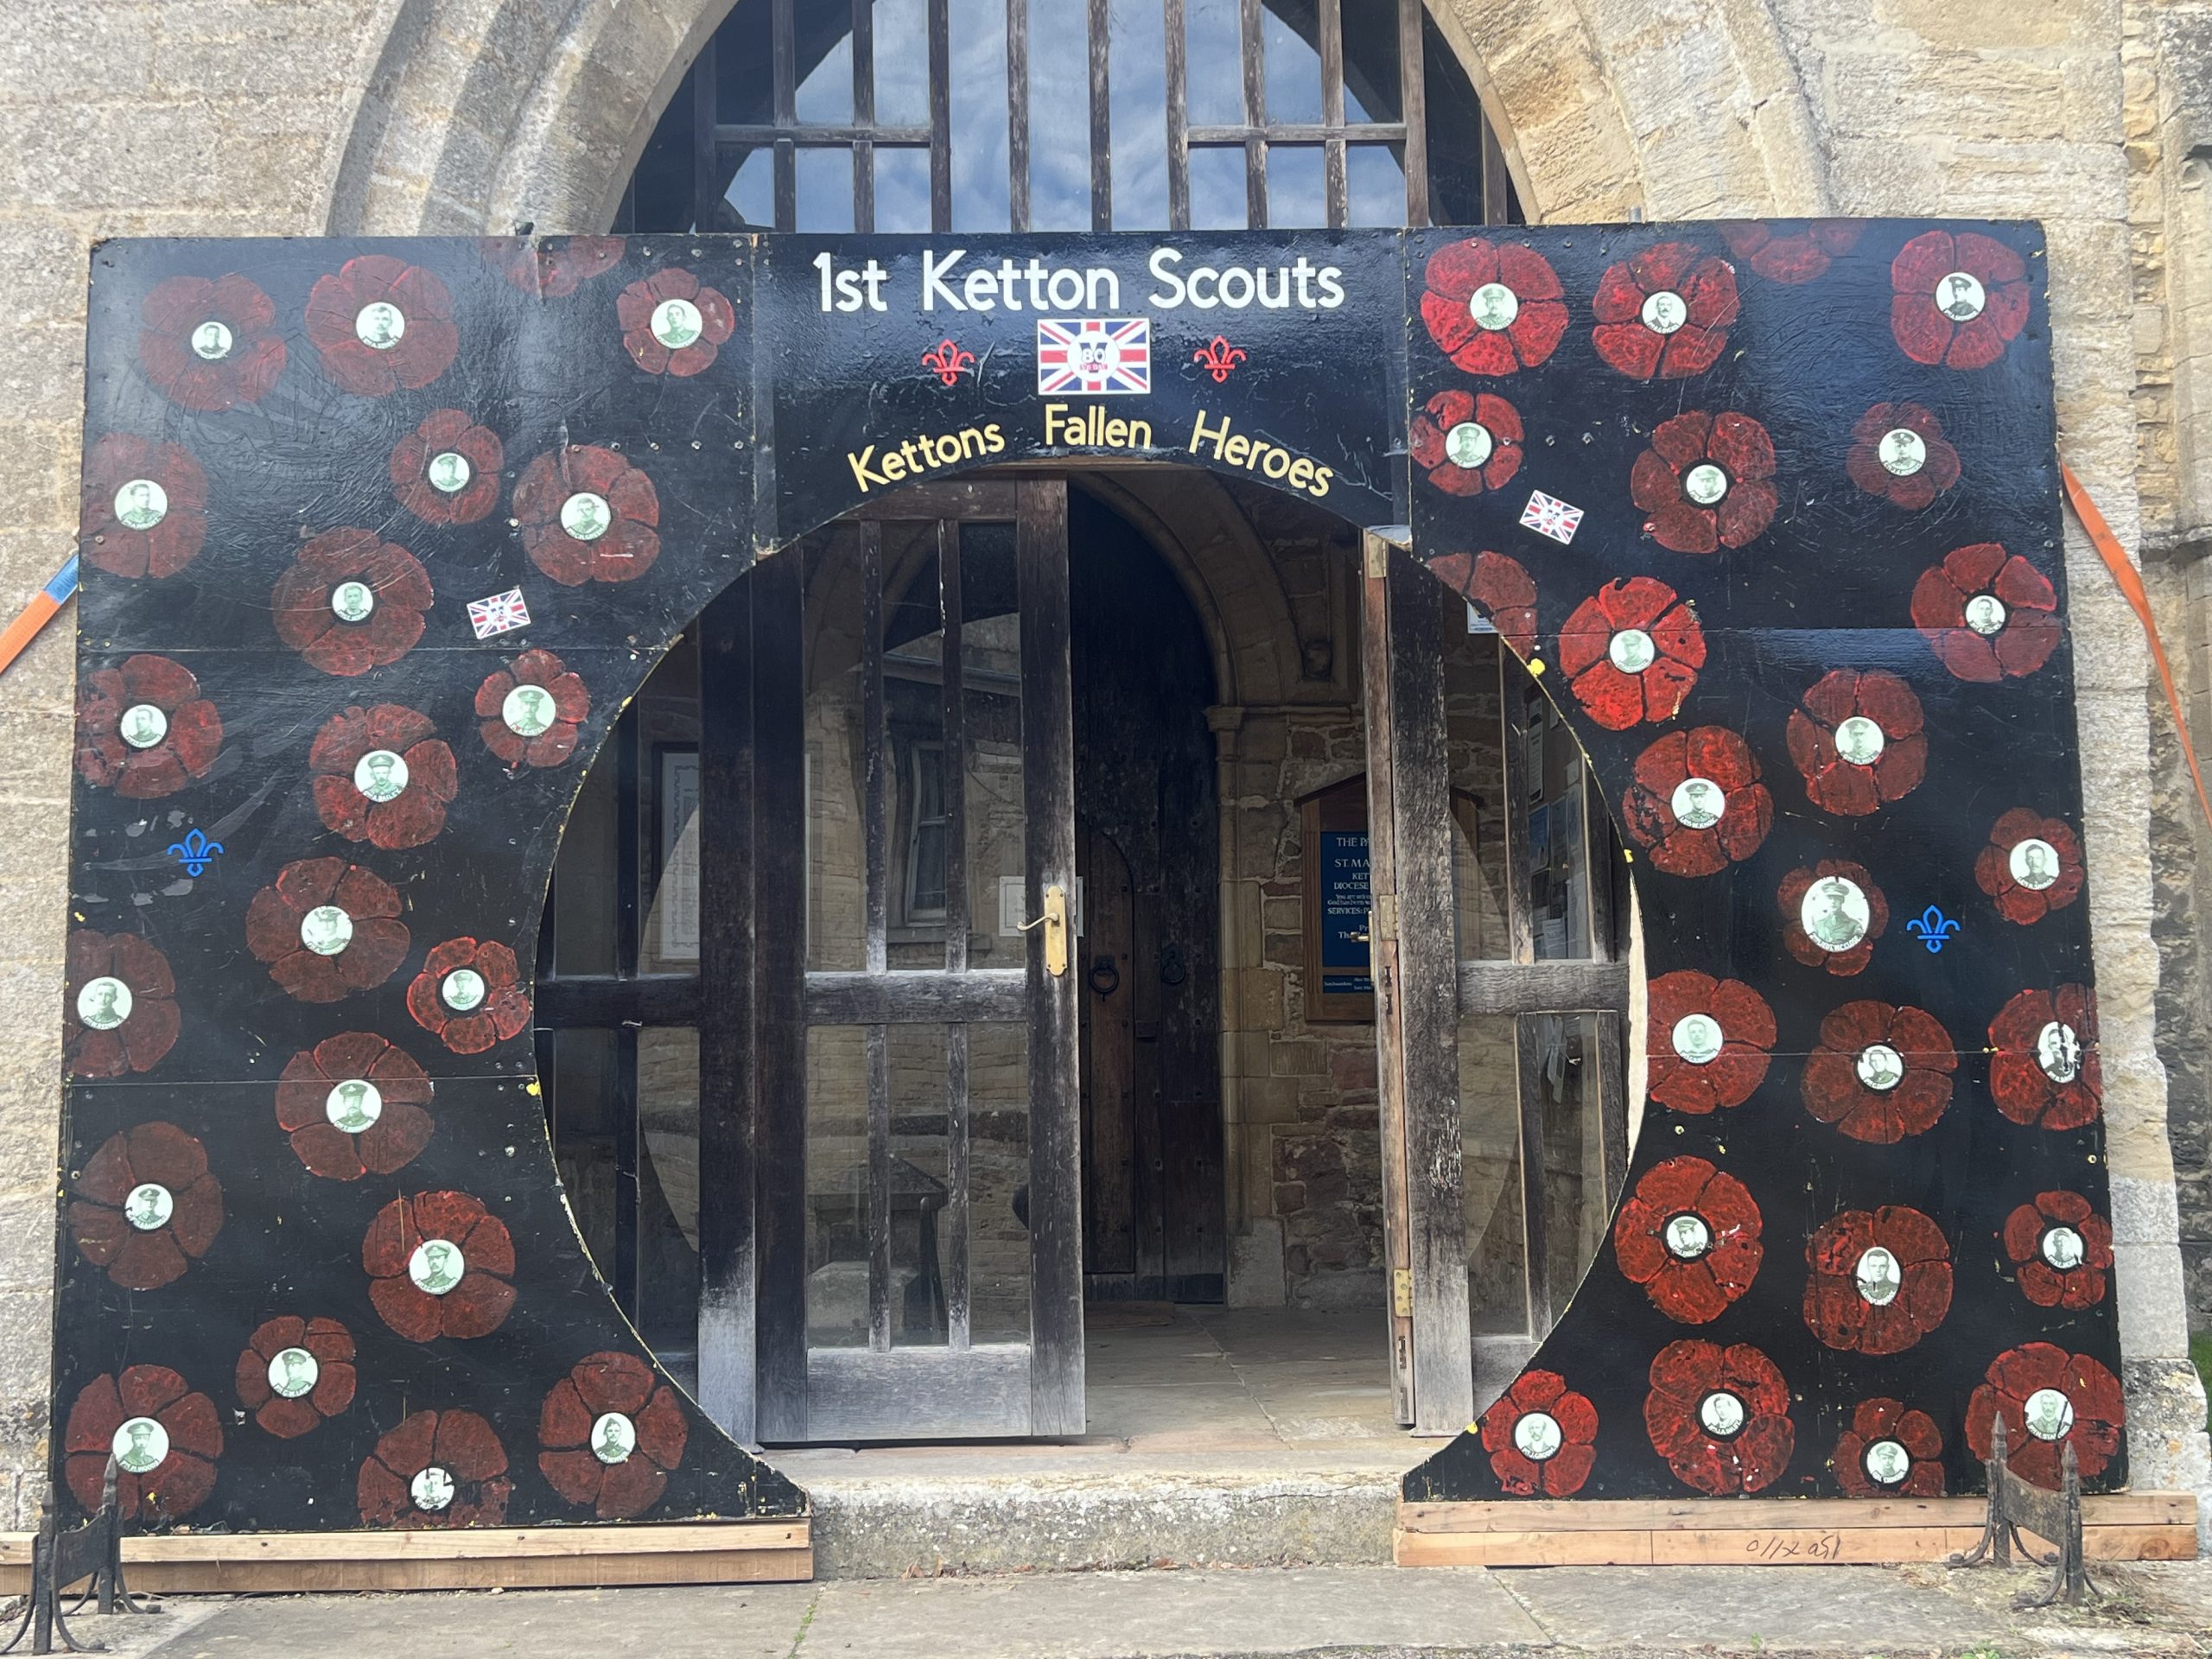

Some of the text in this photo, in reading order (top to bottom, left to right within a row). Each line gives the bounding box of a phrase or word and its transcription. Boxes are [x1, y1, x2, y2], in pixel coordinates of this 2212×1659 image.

[813, 247, 1345, 312] 1st Ketton Scouts
[847, 404, 1334, 497] Kettons Fallen Heroes
[1336, 836, 1357, 847] THE
[1351, 858, 1370, 868] MA
[1351, 872, 1370, 880] KET
[1333, 881, 1370, 891] DIOCESE
